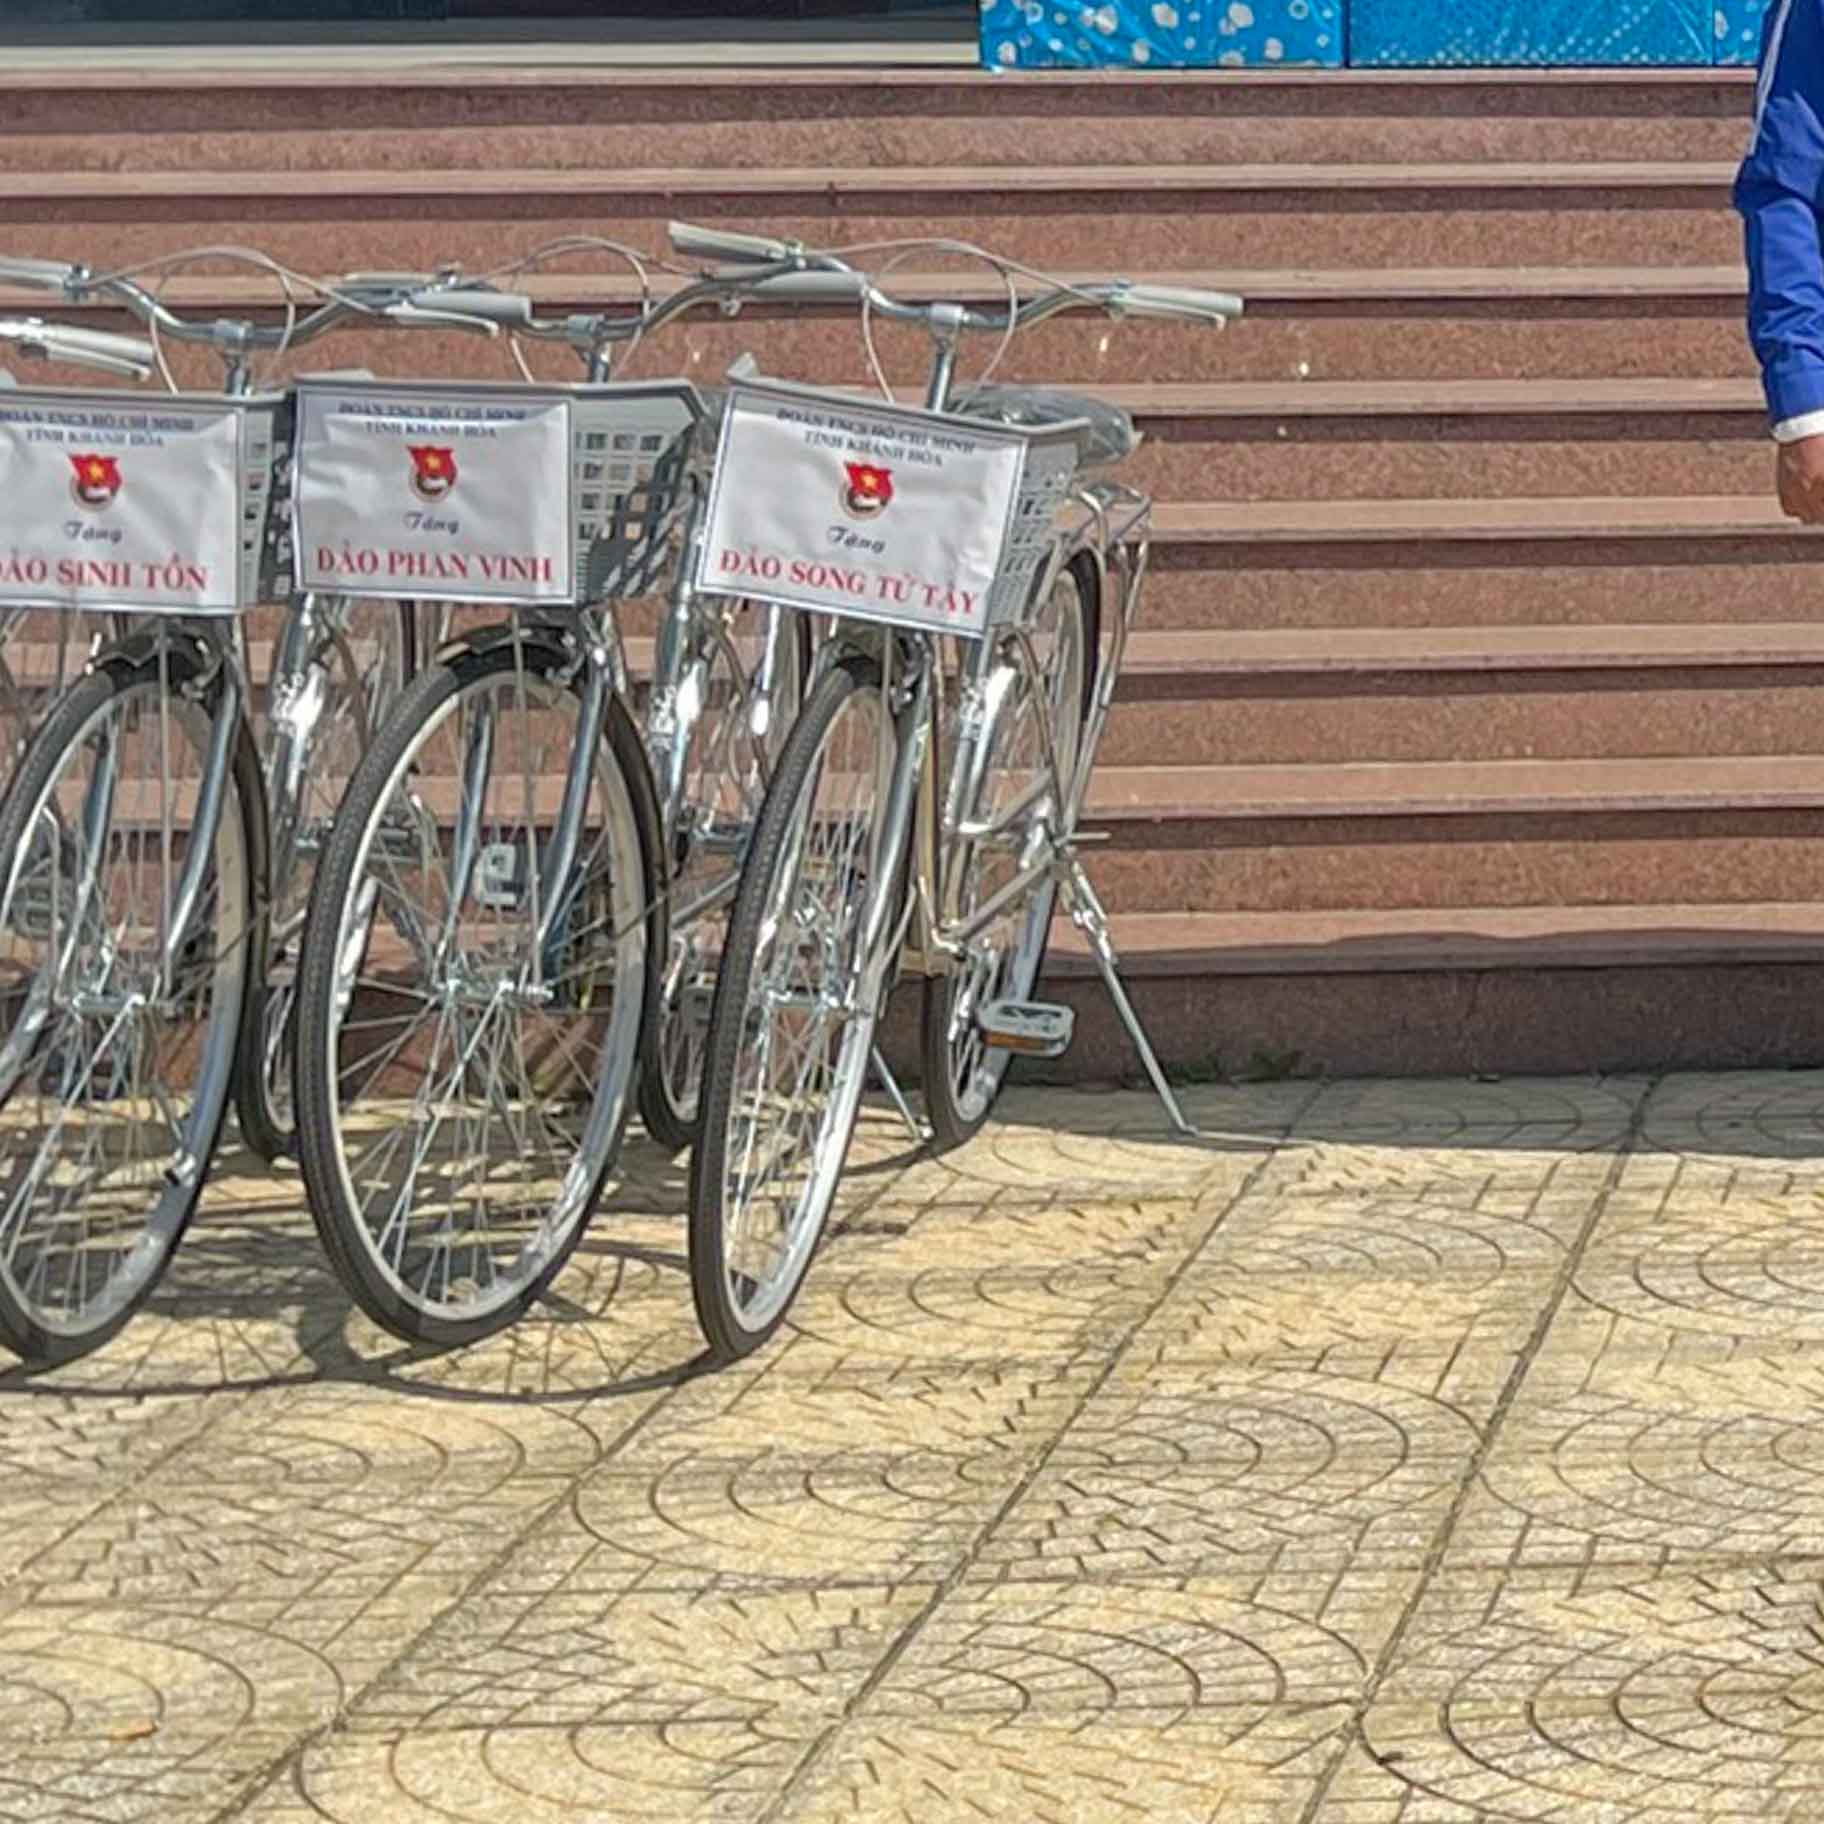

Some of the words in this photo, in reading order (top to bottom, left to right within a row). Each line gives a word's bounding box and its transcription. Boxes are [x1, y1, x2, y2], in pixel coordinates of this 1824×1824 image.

[56, 559, 131, 588] SINH
[143, 552, 207, 590] TỒN
[317, 538, 379, 575] ĐẢO
[388, 551, 468, 579] PHAN
[472, 554, 552, 581] VINH
